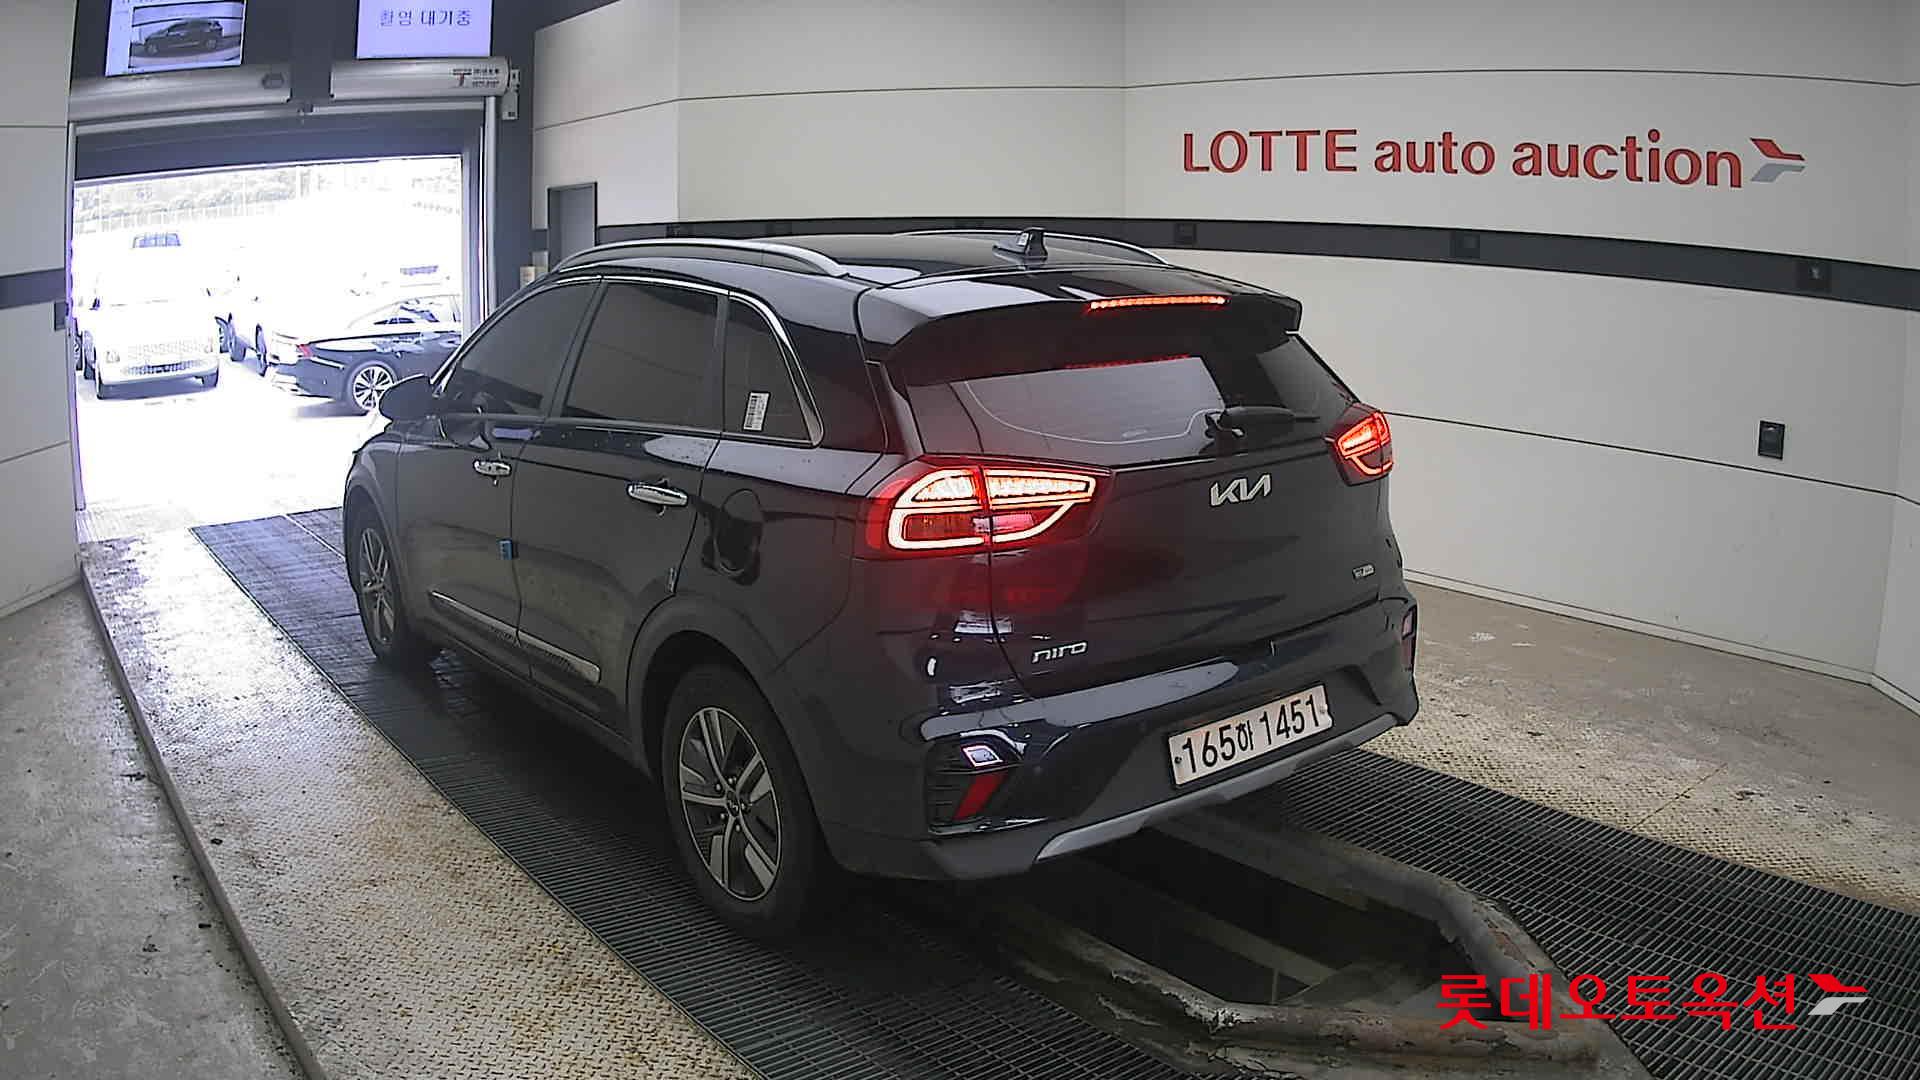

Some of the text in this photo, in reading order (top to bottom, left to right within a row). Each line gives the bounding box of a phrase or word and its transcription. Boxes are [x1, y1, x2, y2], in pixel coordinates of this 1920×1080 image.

[421, 9, 471, 26] 대기중
[1184, 128, 1743, 188] LOTTE auto auction
[1211, 474, 1271, 506] KIA
[1182, 693, 1320, 774] 165하 1451
